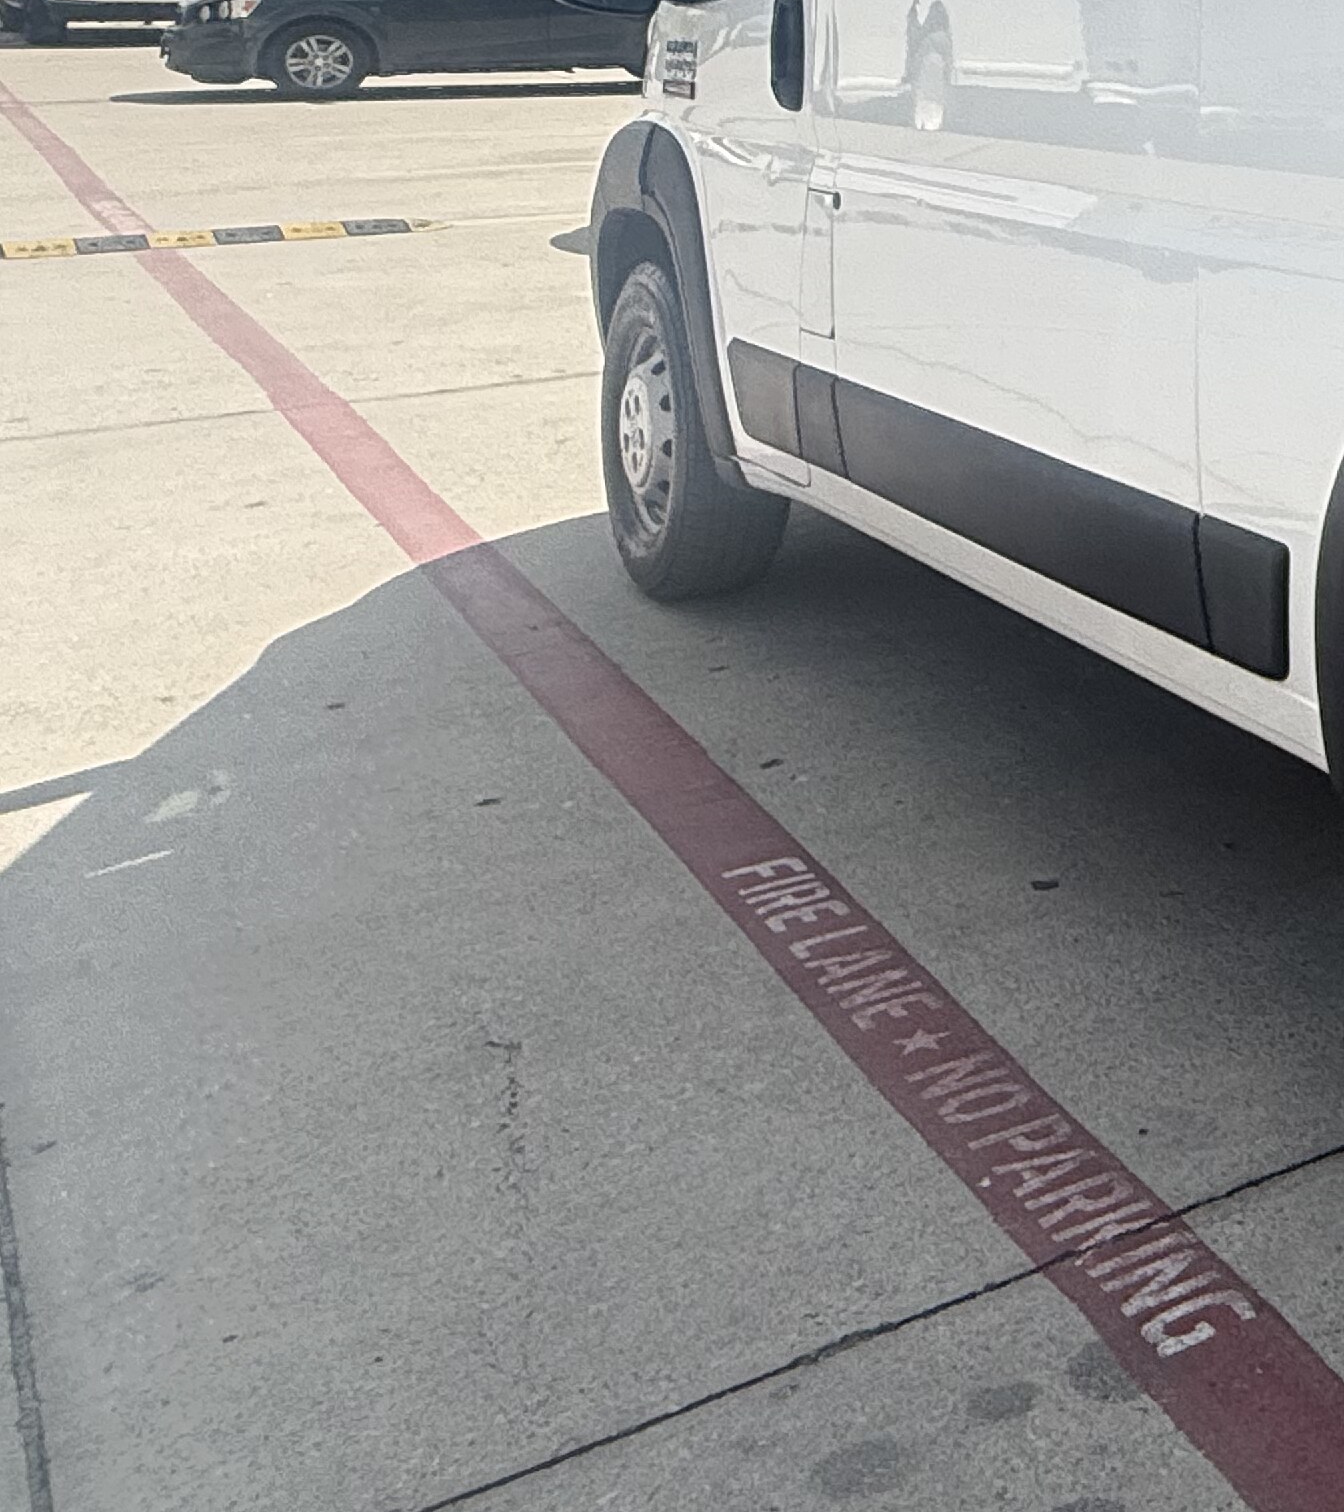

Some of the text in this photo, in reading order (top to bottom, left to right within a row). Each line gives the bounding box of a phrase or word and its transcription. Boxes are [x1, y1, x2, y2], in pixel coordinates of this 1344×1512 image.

[721, 855, 1258, 1359] FIRE LANE NO PARKING
